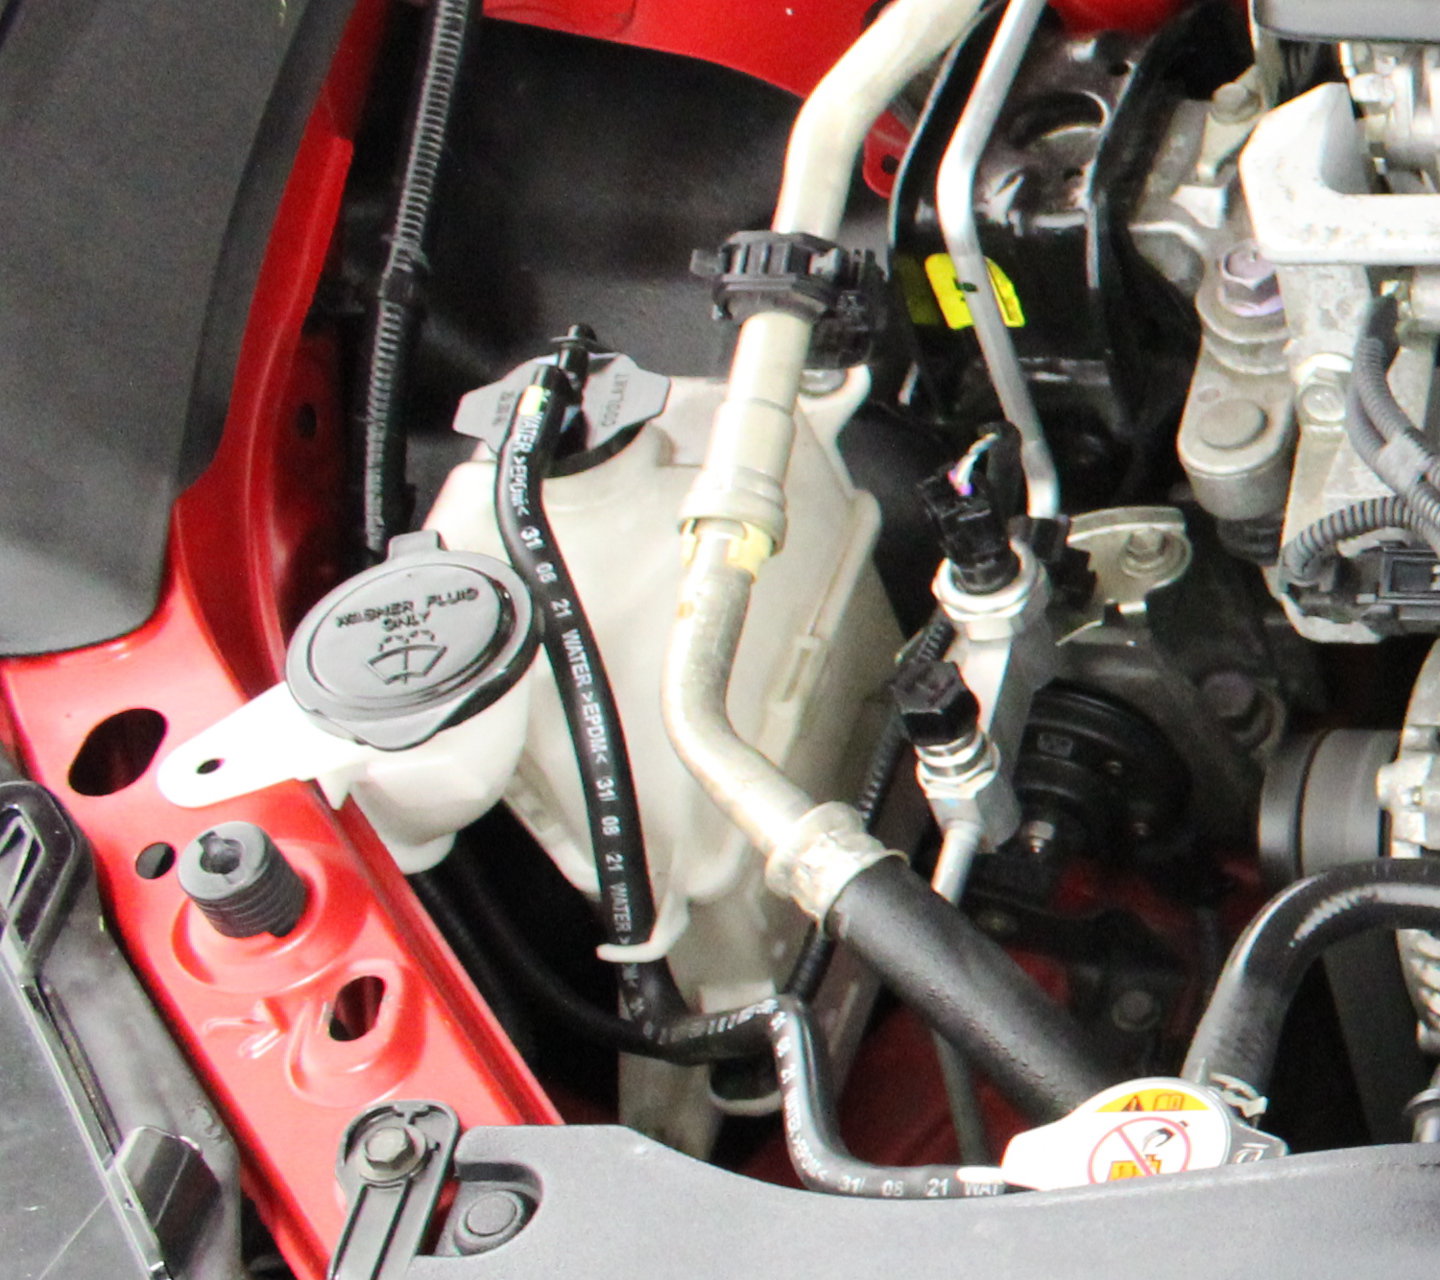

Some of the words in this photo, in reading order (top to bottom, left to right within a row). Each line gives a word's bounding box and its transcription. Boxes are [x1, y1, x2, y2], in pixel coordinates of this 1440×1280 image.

[550, 598, 573, 618] 21
[382, 611, 431, 631] ONLY
[561, 628, 592, 687] WATER
[604, 853, 624, 873] 21
[608, 881, 632, 933] WATER
[925, 1178, 949, 1197] 21
